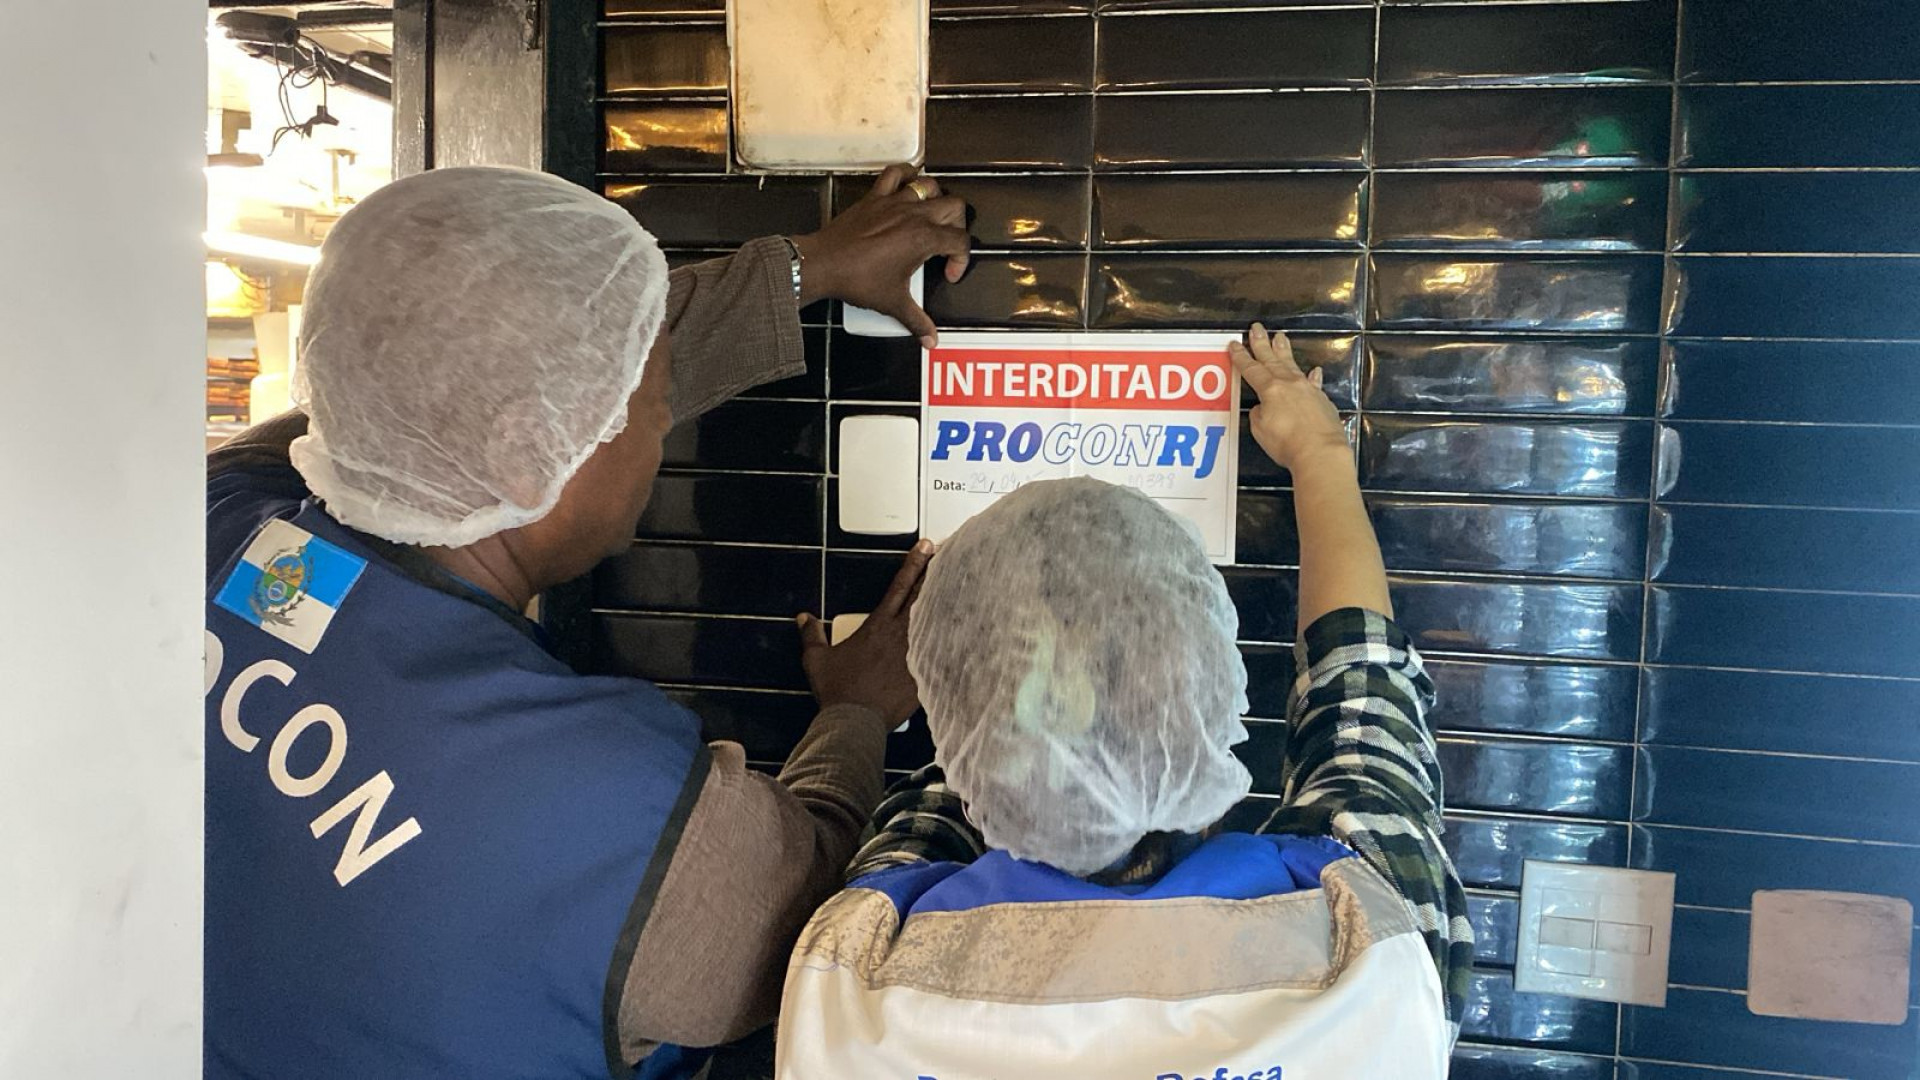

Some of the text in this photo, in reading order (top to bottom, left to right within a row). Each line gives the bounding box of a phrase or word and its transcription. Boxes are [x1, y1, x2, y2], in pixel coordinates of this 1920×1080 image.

[933, 361, 1227, 400] INTERDITADO
[931, 420, 1226, 479] PROCONRJ
[934, 480, 966, 491] Data:
